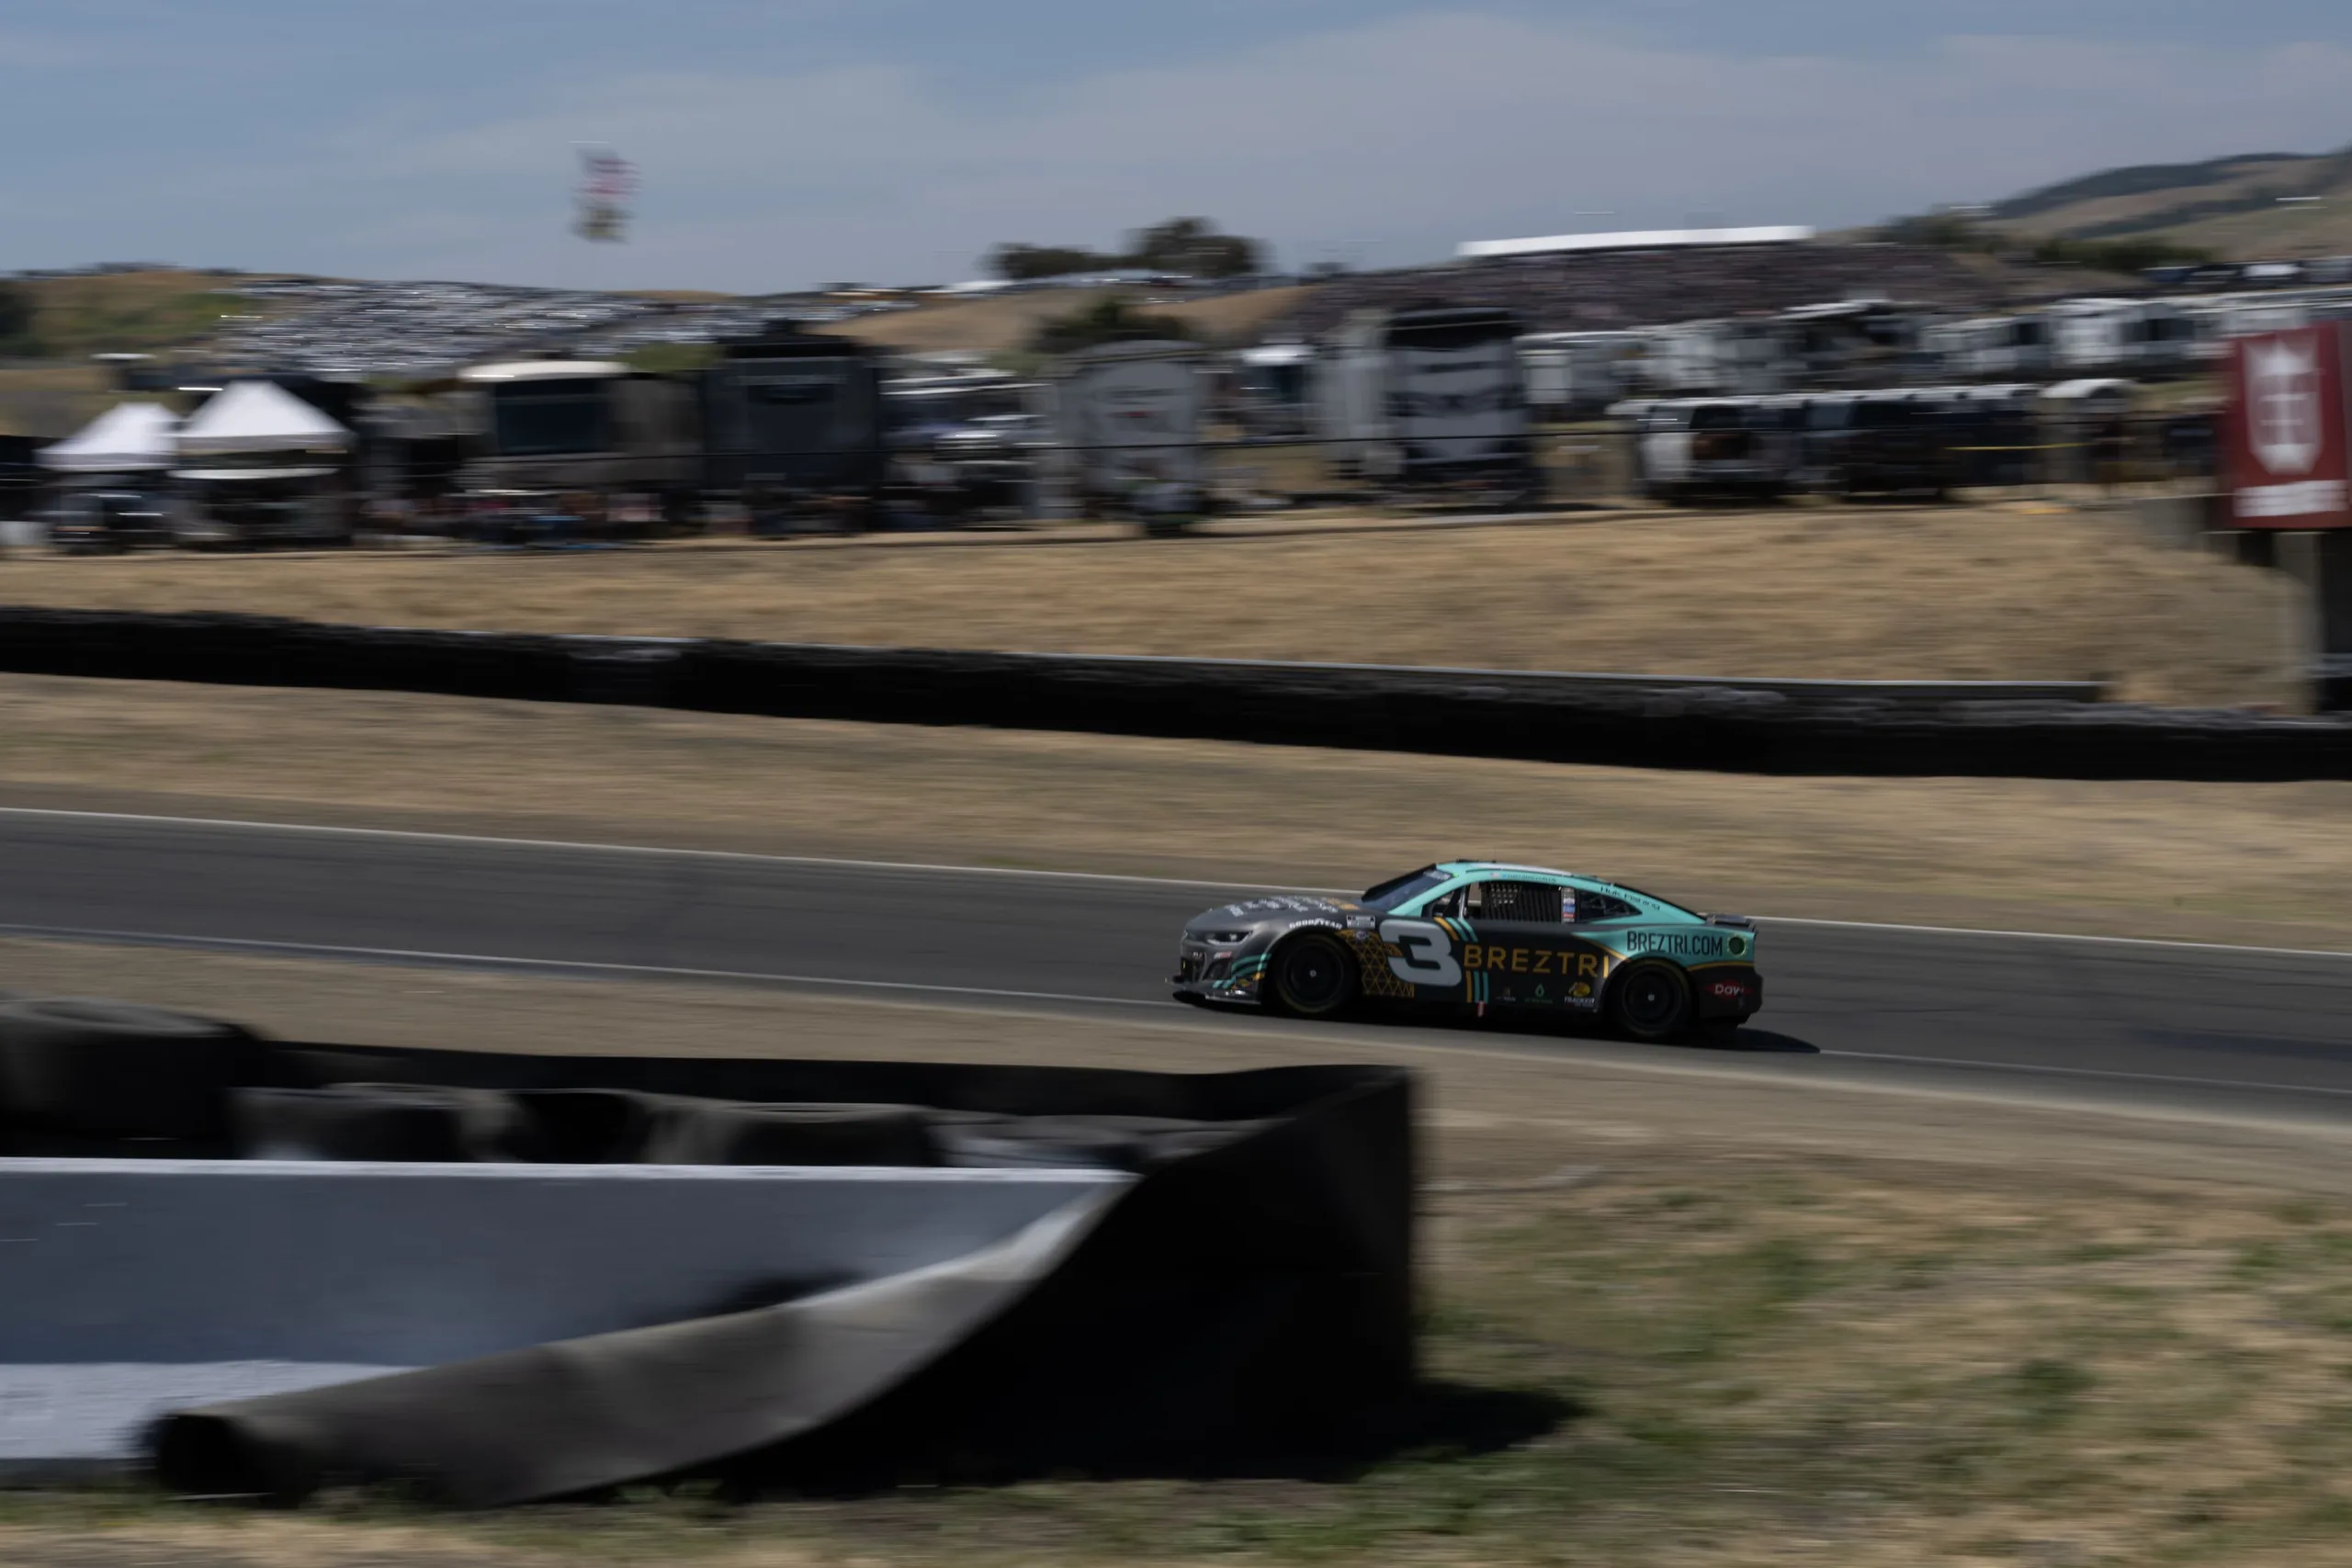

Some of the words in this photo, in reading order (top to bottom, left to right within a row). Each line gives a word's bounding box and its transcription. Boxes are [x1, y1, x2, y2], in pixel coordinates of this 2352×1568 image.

[1379, 919, 1463, 987] 3
[1464, 943, 1610, 978] BREZTRI
[1626, 931, 1724, 957] BREZTRI.COM
